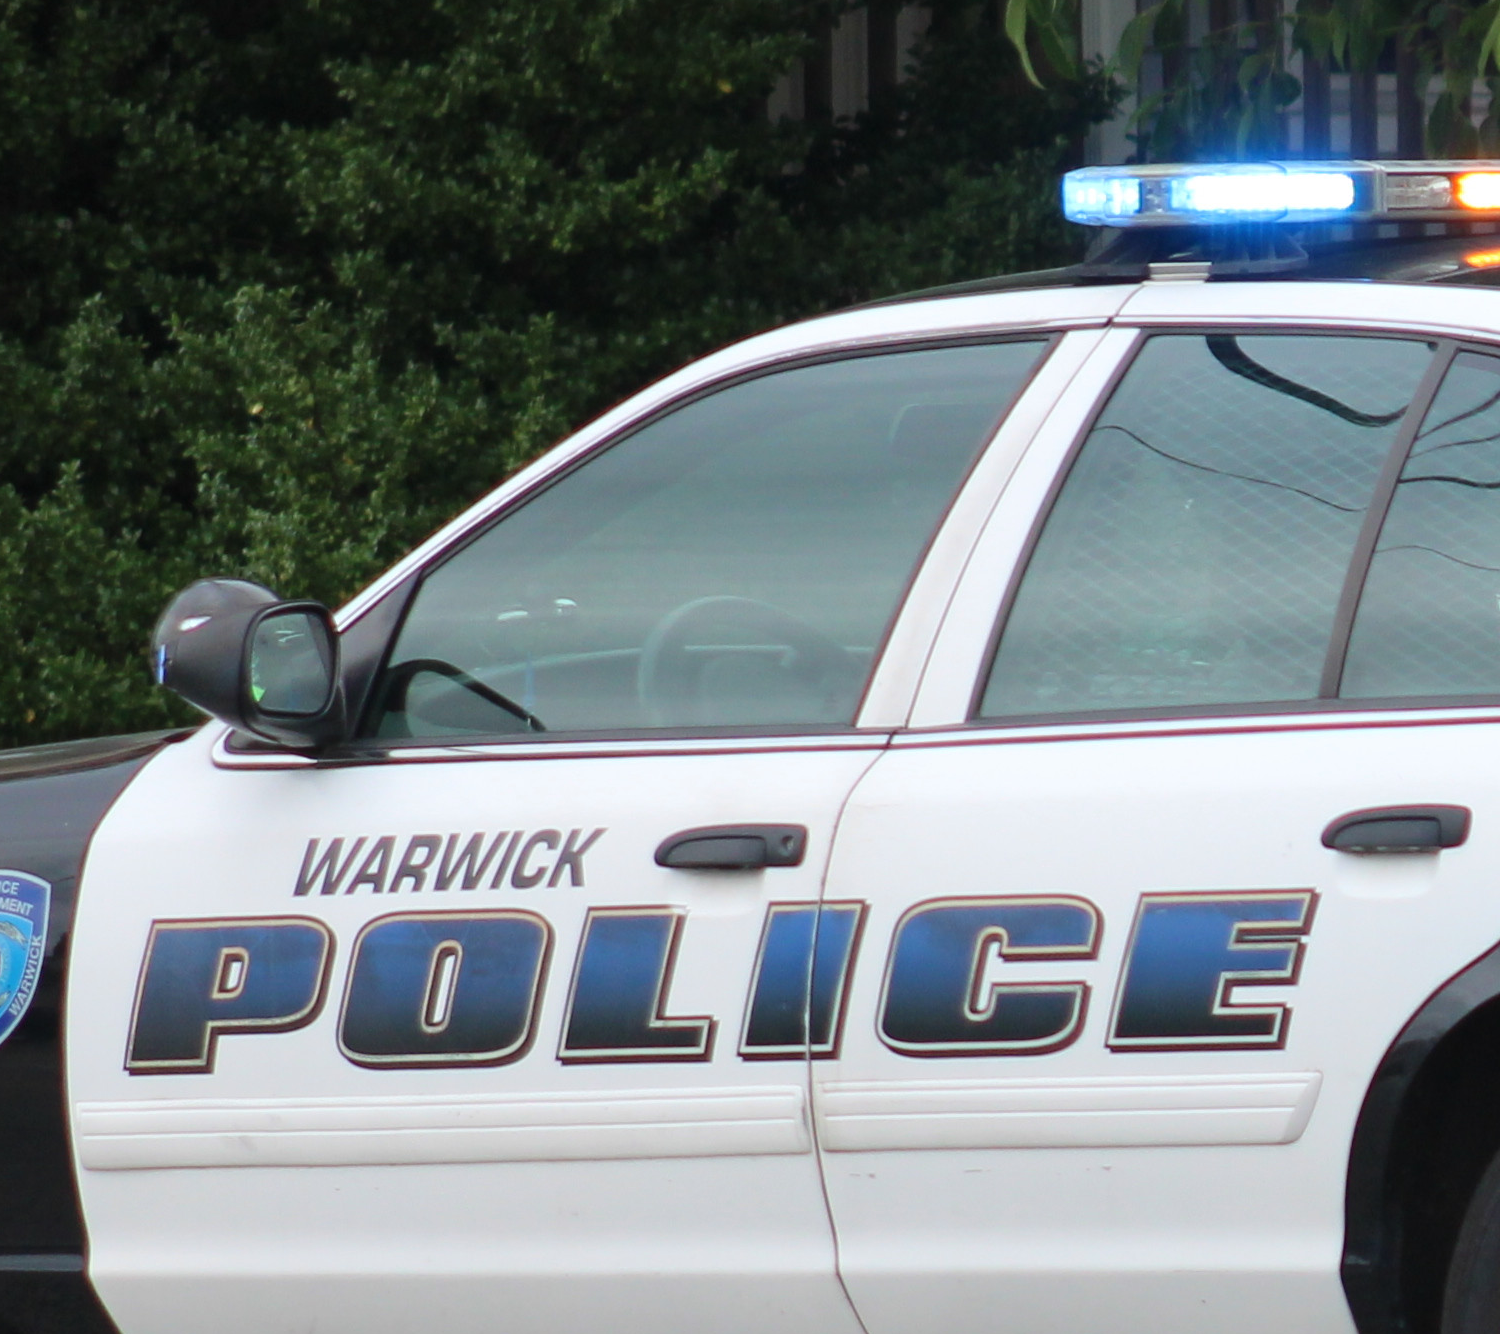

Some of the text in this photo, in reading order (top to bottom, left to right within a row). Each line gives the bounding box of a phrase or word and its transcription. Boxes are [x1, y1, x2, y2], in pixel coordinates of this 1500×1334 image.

[293, 827, 608, 897] WARWICK
[10, 935, 42, 1015] WARWICK
[125, 888, 1322, 1073] POLICE
